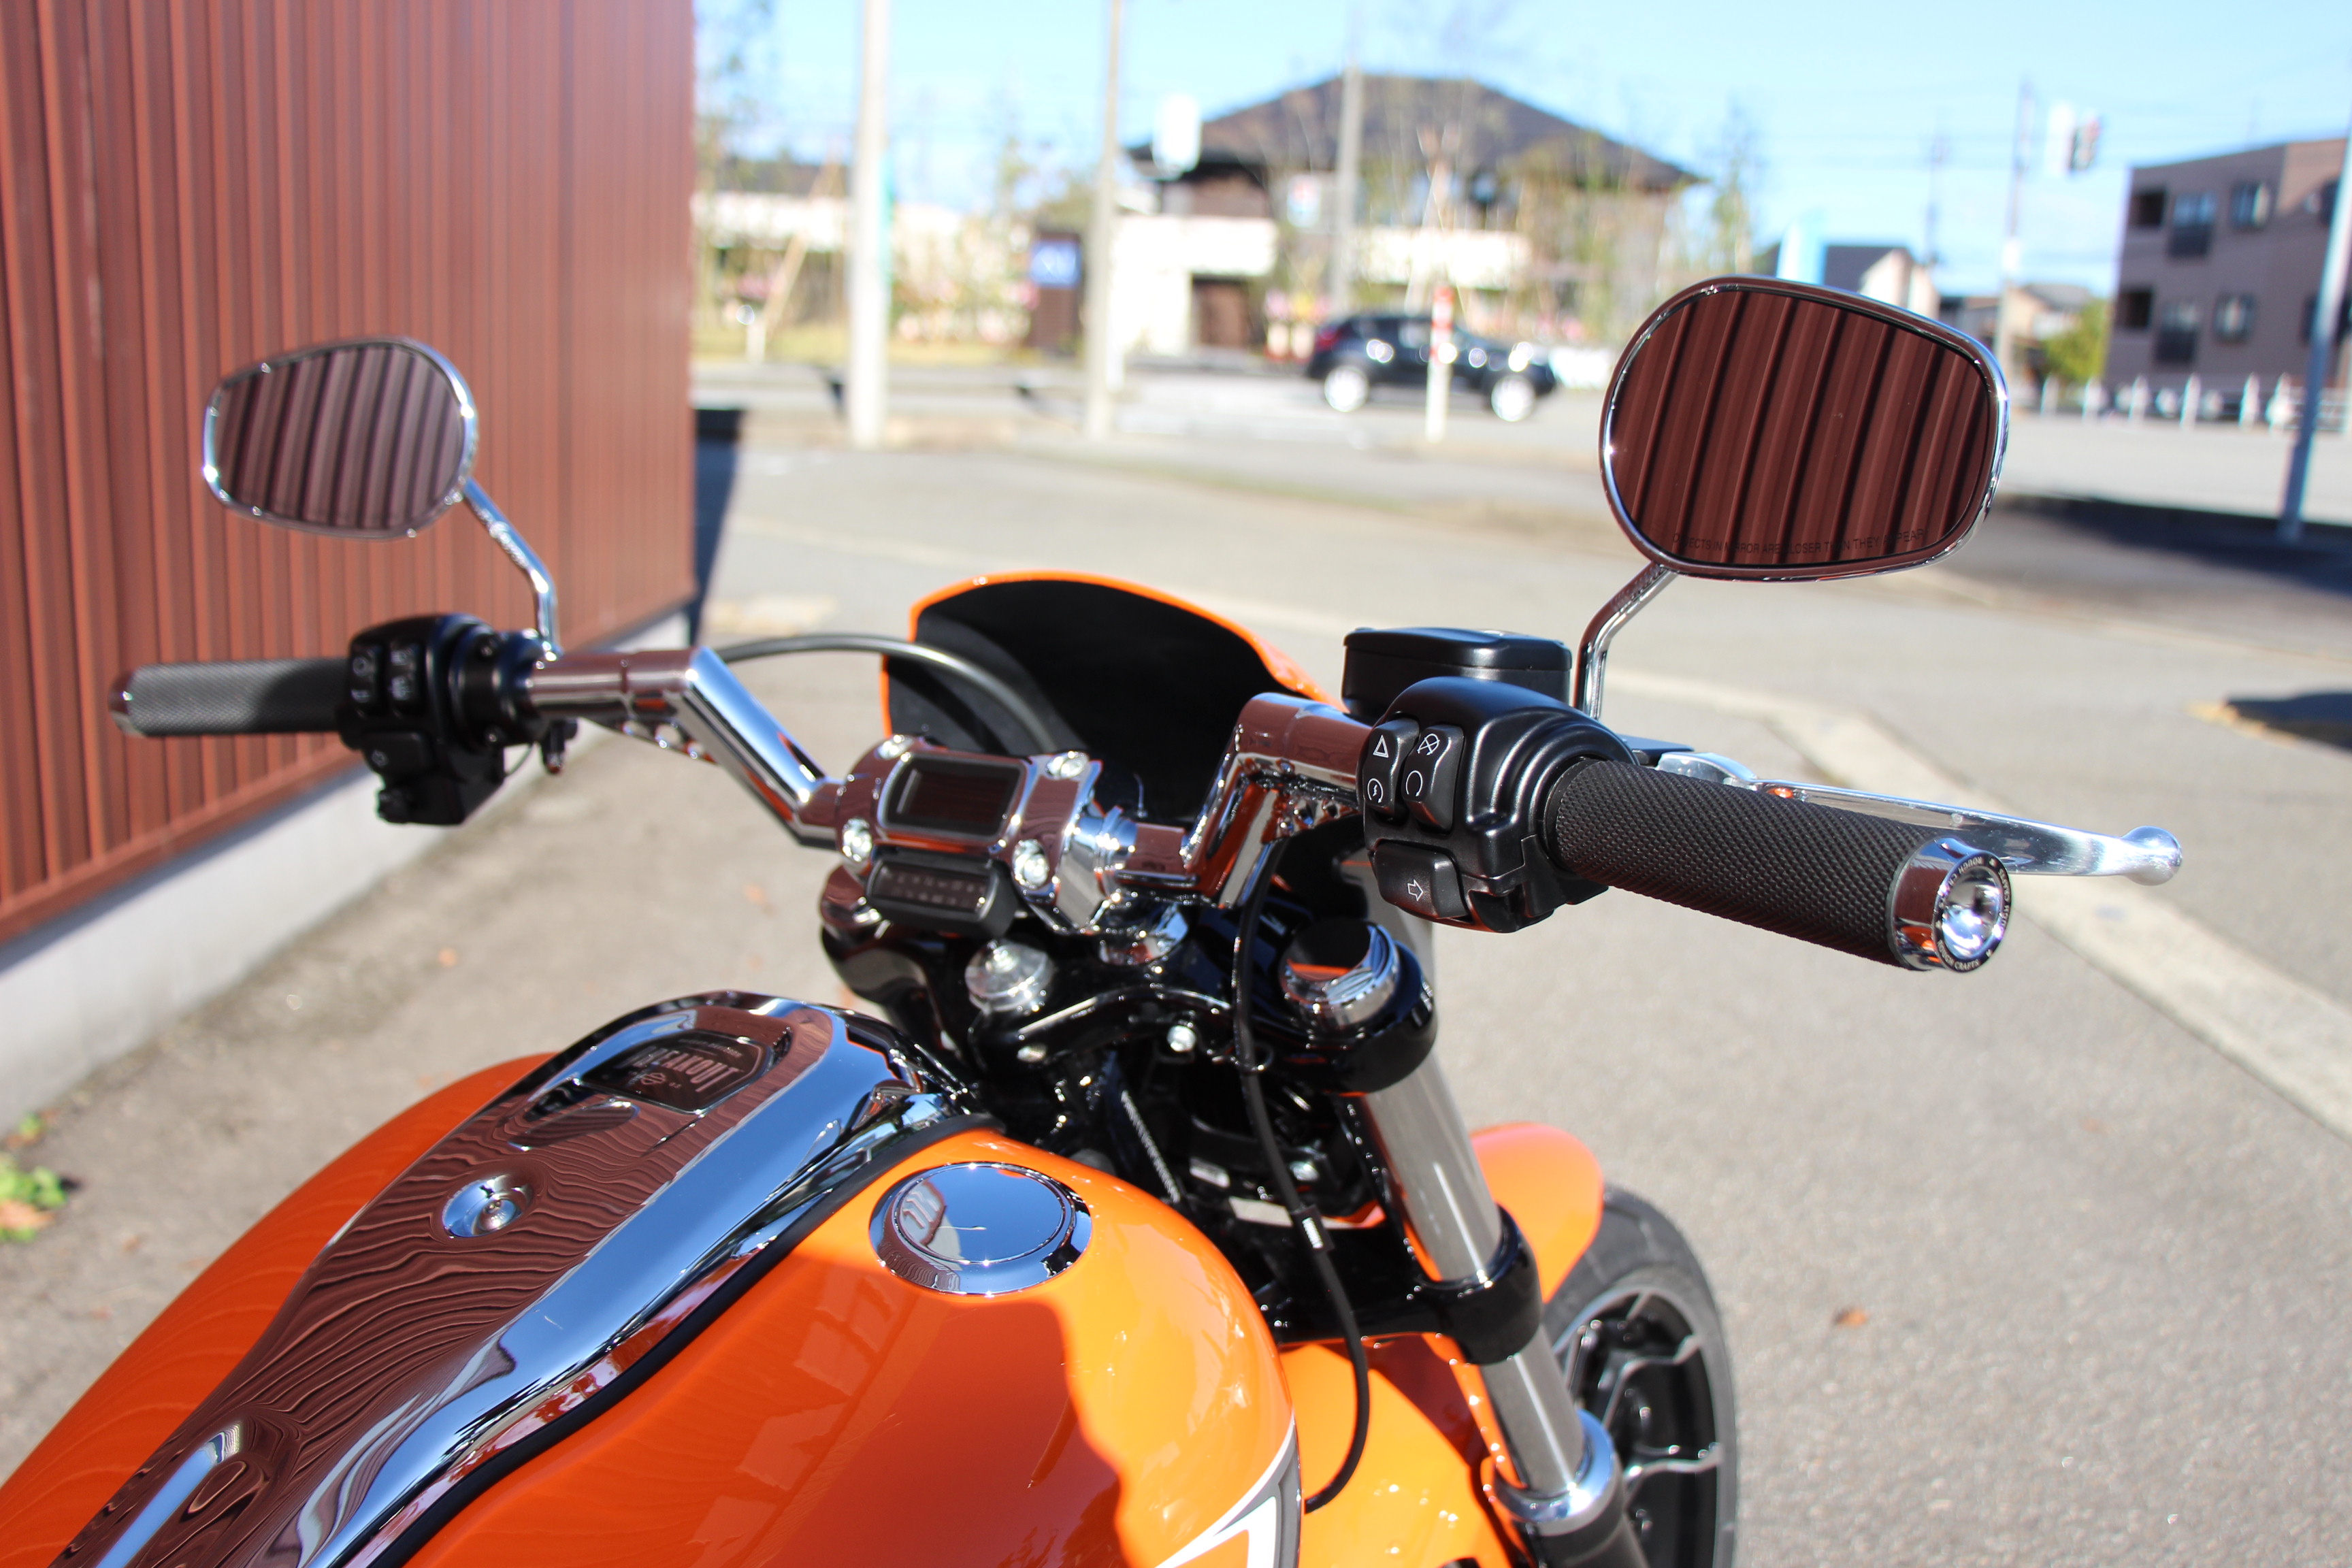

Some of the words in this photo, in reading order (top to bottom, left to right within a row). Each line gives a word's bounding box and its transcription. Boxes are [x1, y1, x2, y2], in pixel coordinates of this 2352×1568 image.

[1673, 532, 1711, 550] OJECTS
[1713, 540, 1722, 551] IN
[1724, 542, 1759, 553] MRROR
[1763, 543, 1780, 554] ARE
[1784, 542, 1821, 554] LOSER
[1824, 540, 1850, 552] THN
[1853, 536, 1879, 549] THEY
[1883, 528, 1924, 546] APEAR
[1958, 856, 1982, 875] ROUGH
